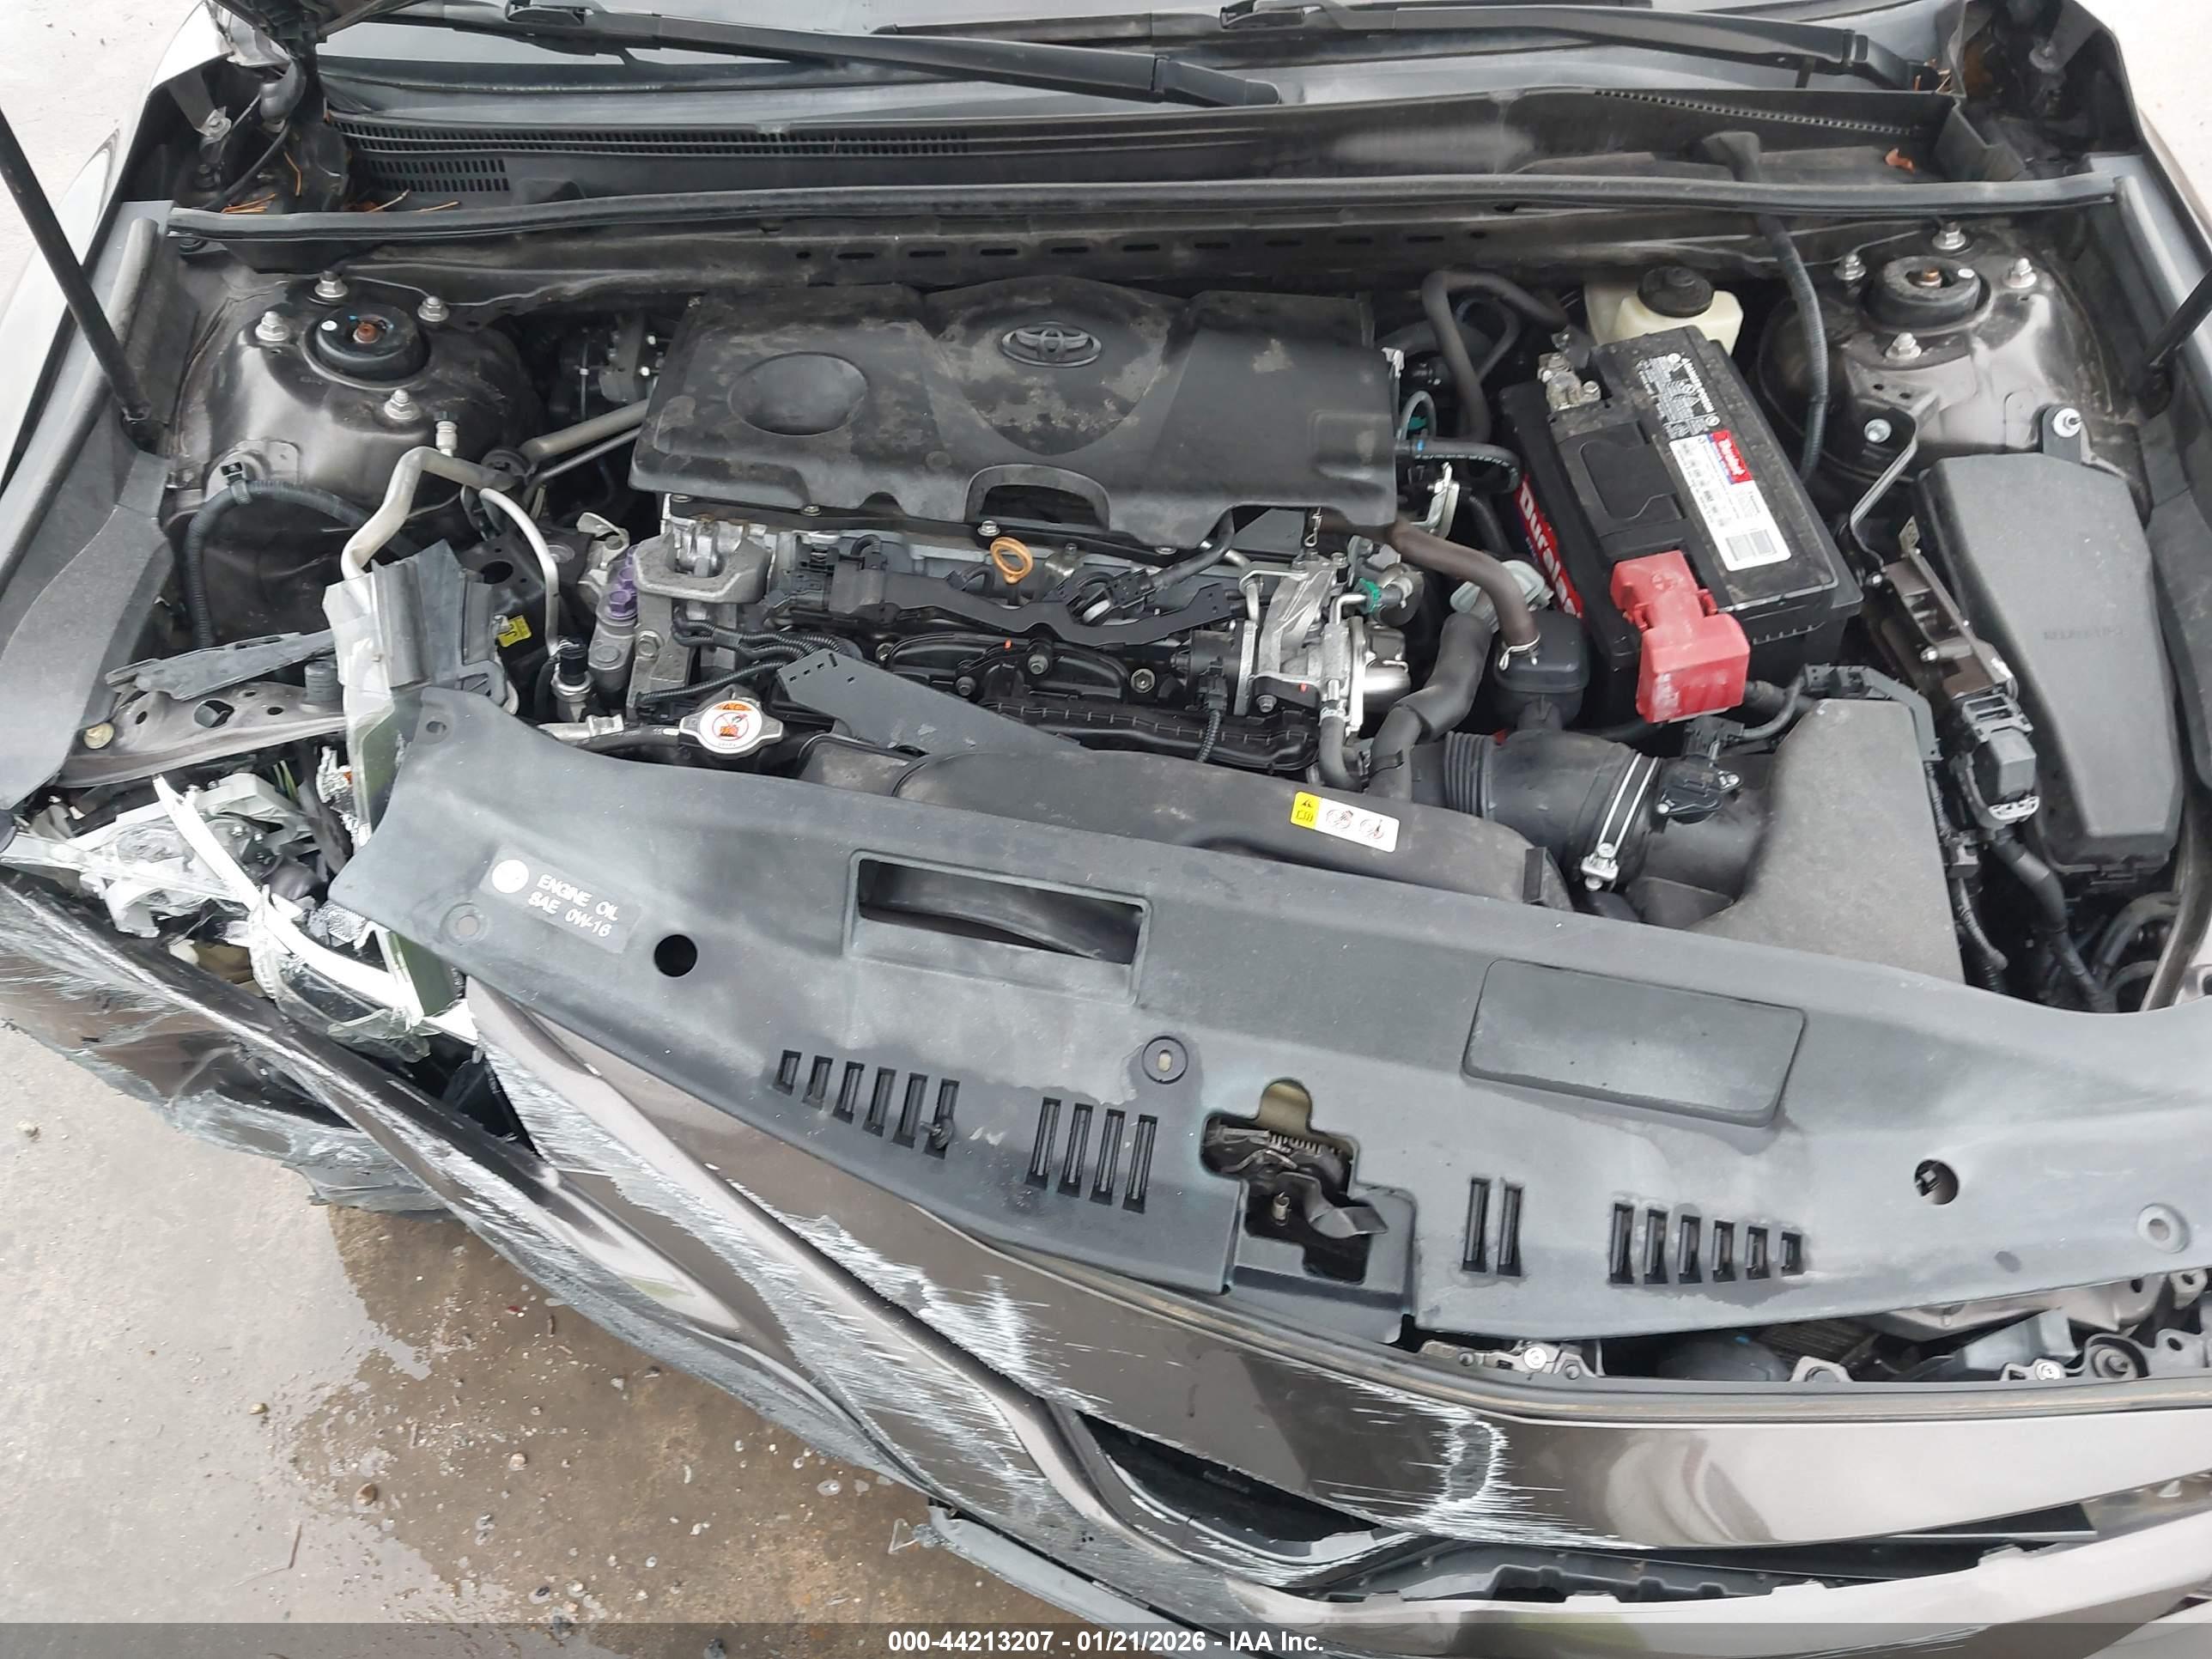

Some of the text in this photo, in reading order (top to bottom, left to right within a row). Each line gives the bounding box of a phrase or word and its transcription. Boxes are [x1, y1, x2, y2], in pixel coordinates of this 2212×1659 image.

[1519, 480, 1583, 619] Duralas
[528, 891, 612, 937] SAE 0W-16
[537, 873, 618, 921] ENGINE OIL
